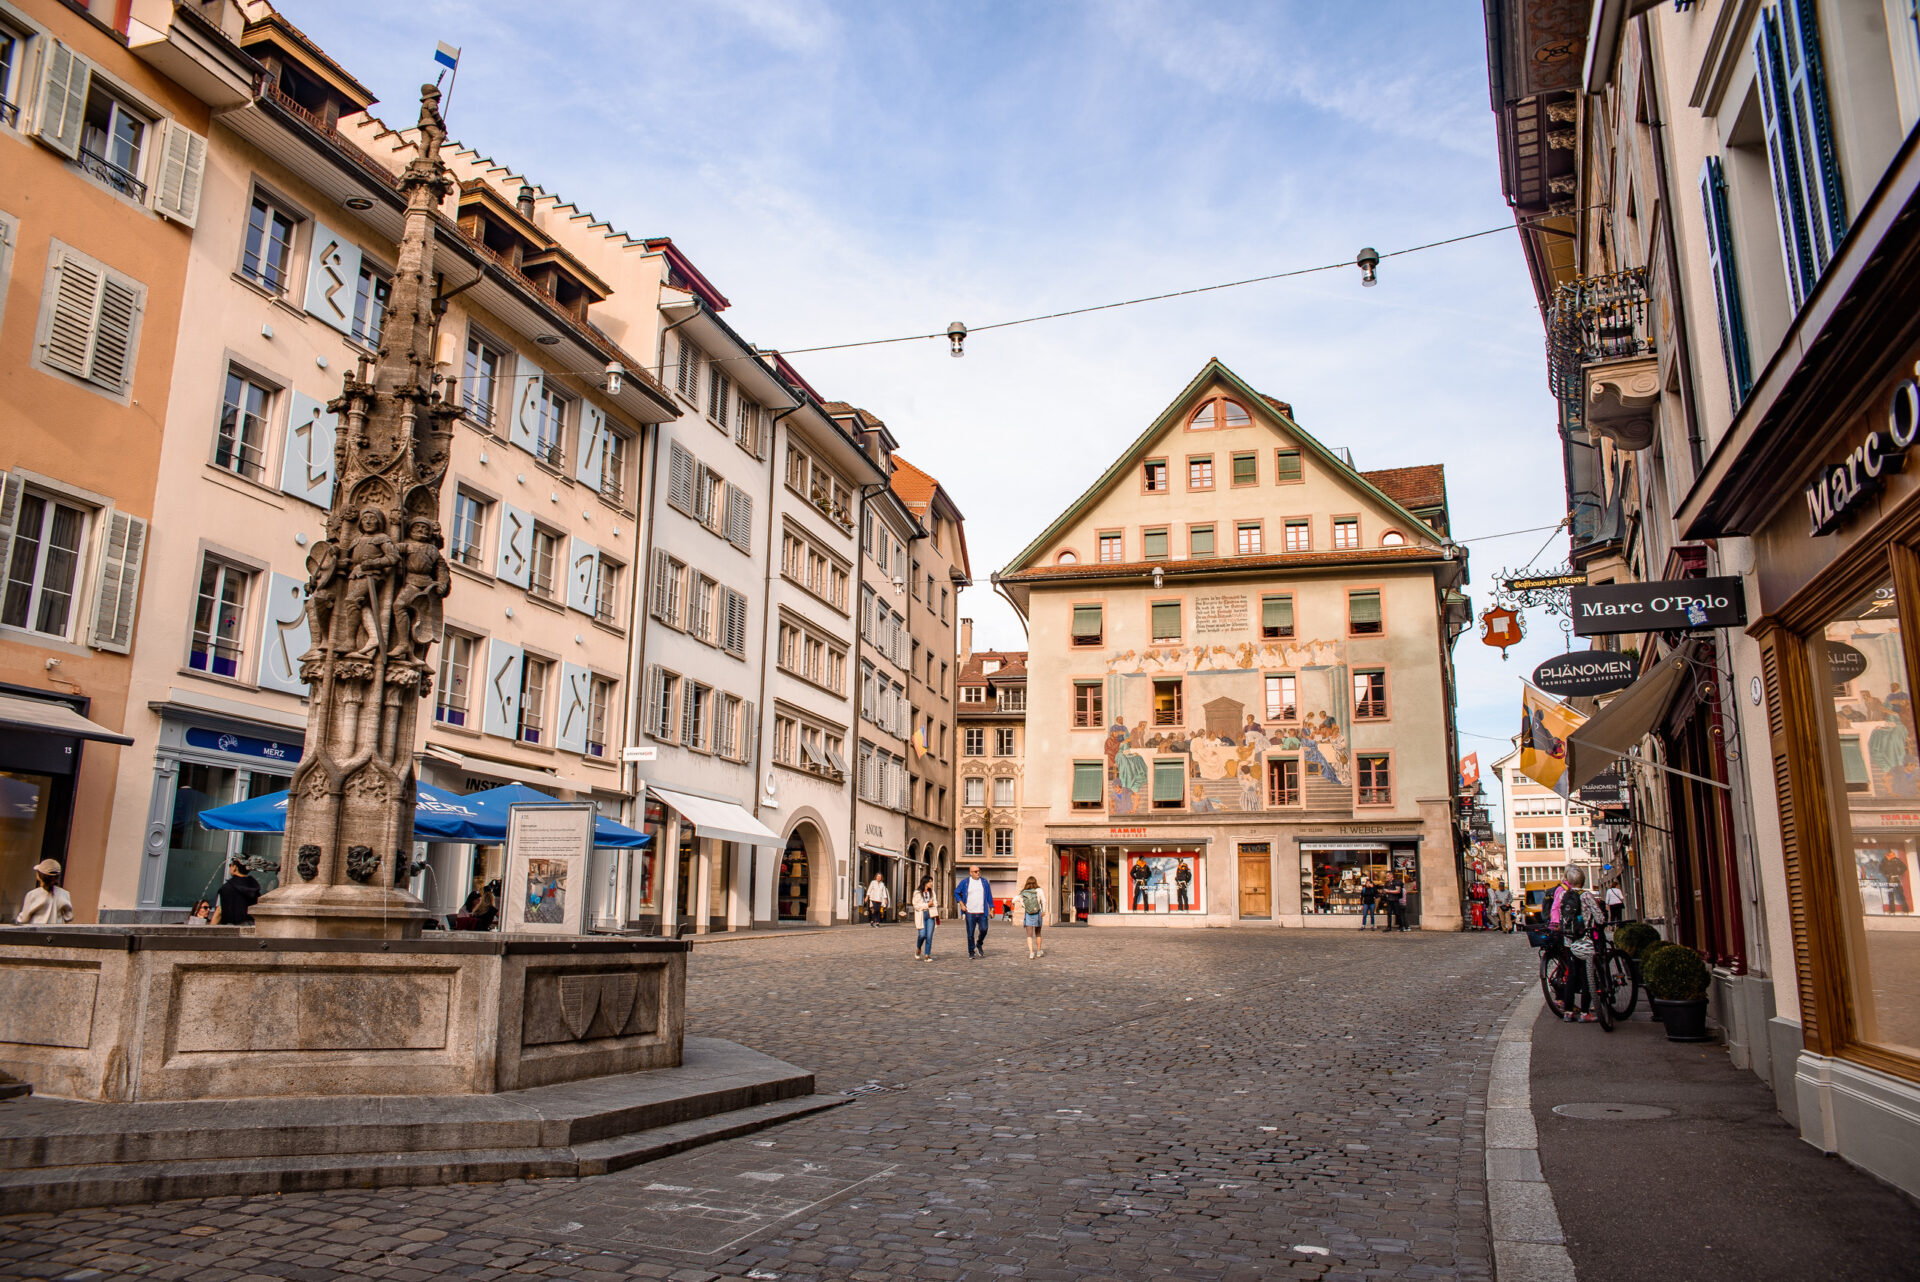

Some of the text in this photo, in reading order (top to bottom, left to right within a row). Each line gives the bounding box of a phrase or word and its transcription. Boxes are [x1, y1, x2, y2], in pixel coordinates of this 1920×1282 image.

[1804, 431, 1884, 537] Marc
[1581, 594, 1729, 617] Marc O'Polo
[1540, 660, 1632, 679] PHÄNOMEN
[1541, 673, 1632, 687] FASHION AND LIFESTYLE
[64, 746, 72, 754] 13
[263, 747, 285, 758] MERZ
[865, 824, 883, 838] ANOUK
[1340, 826, 1348, 834] H.
[1350, 826, 1384, 834] WEBER
